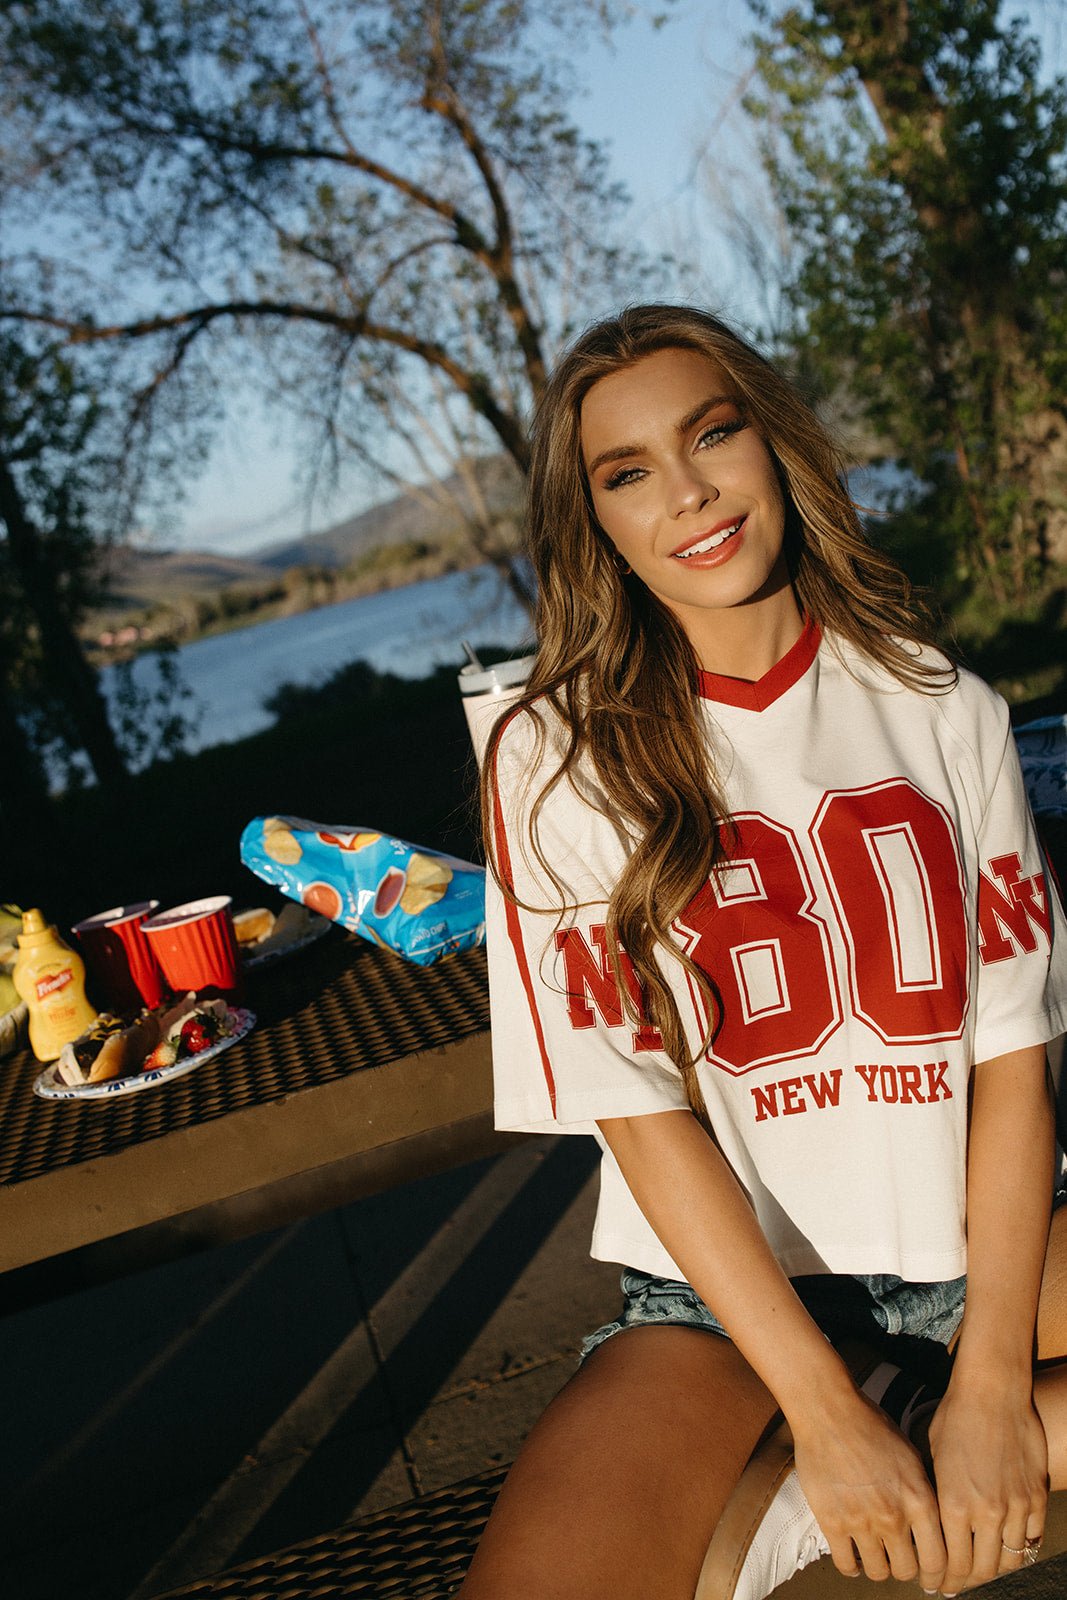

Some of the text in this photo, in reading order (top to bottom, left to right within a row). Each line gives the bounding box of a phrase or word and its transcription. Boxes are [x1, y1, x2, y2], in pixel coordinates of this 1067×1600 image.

[670, 777, 971, 1077] 80
[750, 1061, 953, 1122] NEW YORK
